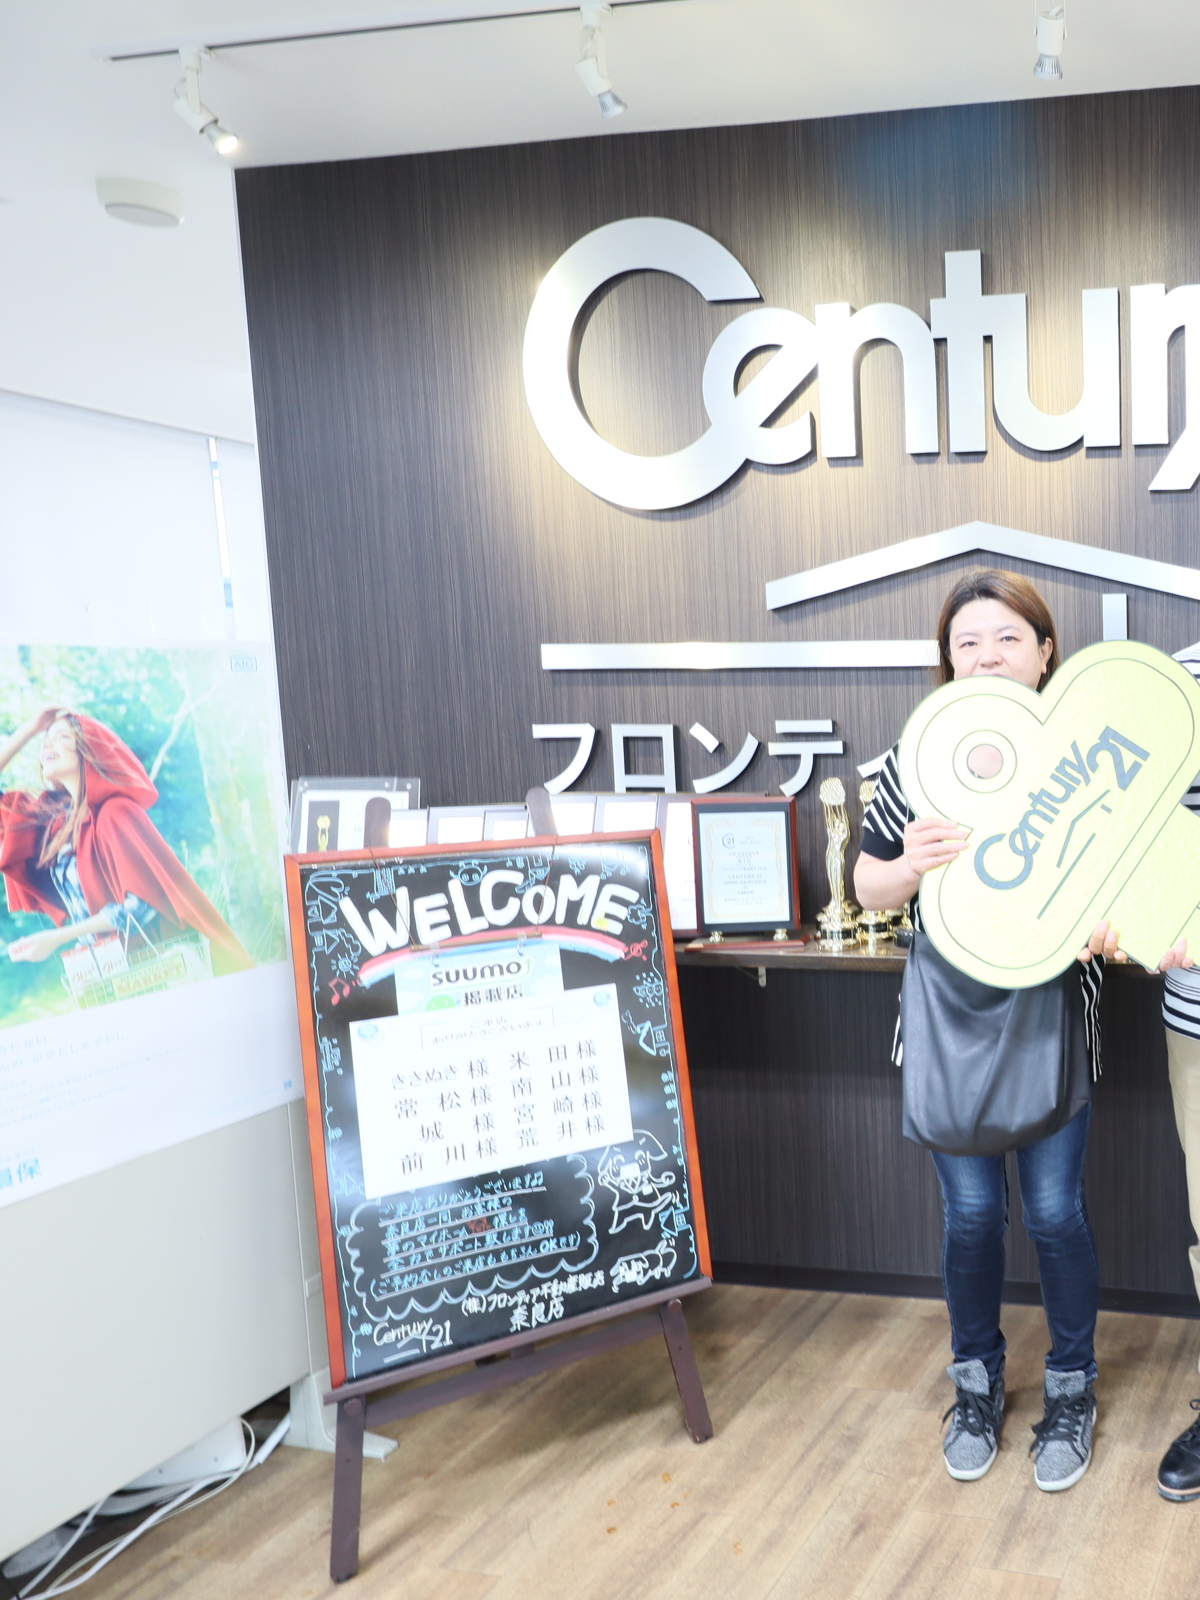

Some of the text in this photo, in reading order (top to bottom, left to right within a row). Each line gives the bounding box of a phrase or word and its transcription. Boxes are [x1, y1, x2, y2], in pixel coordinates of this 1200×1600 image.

[973, 725, 1151, 891] Century 21
[339, 869, 640, 957] WELCOME
[463, 984, 524, 1007] 掲載店
[373, 1317, 434, 1353] Century
